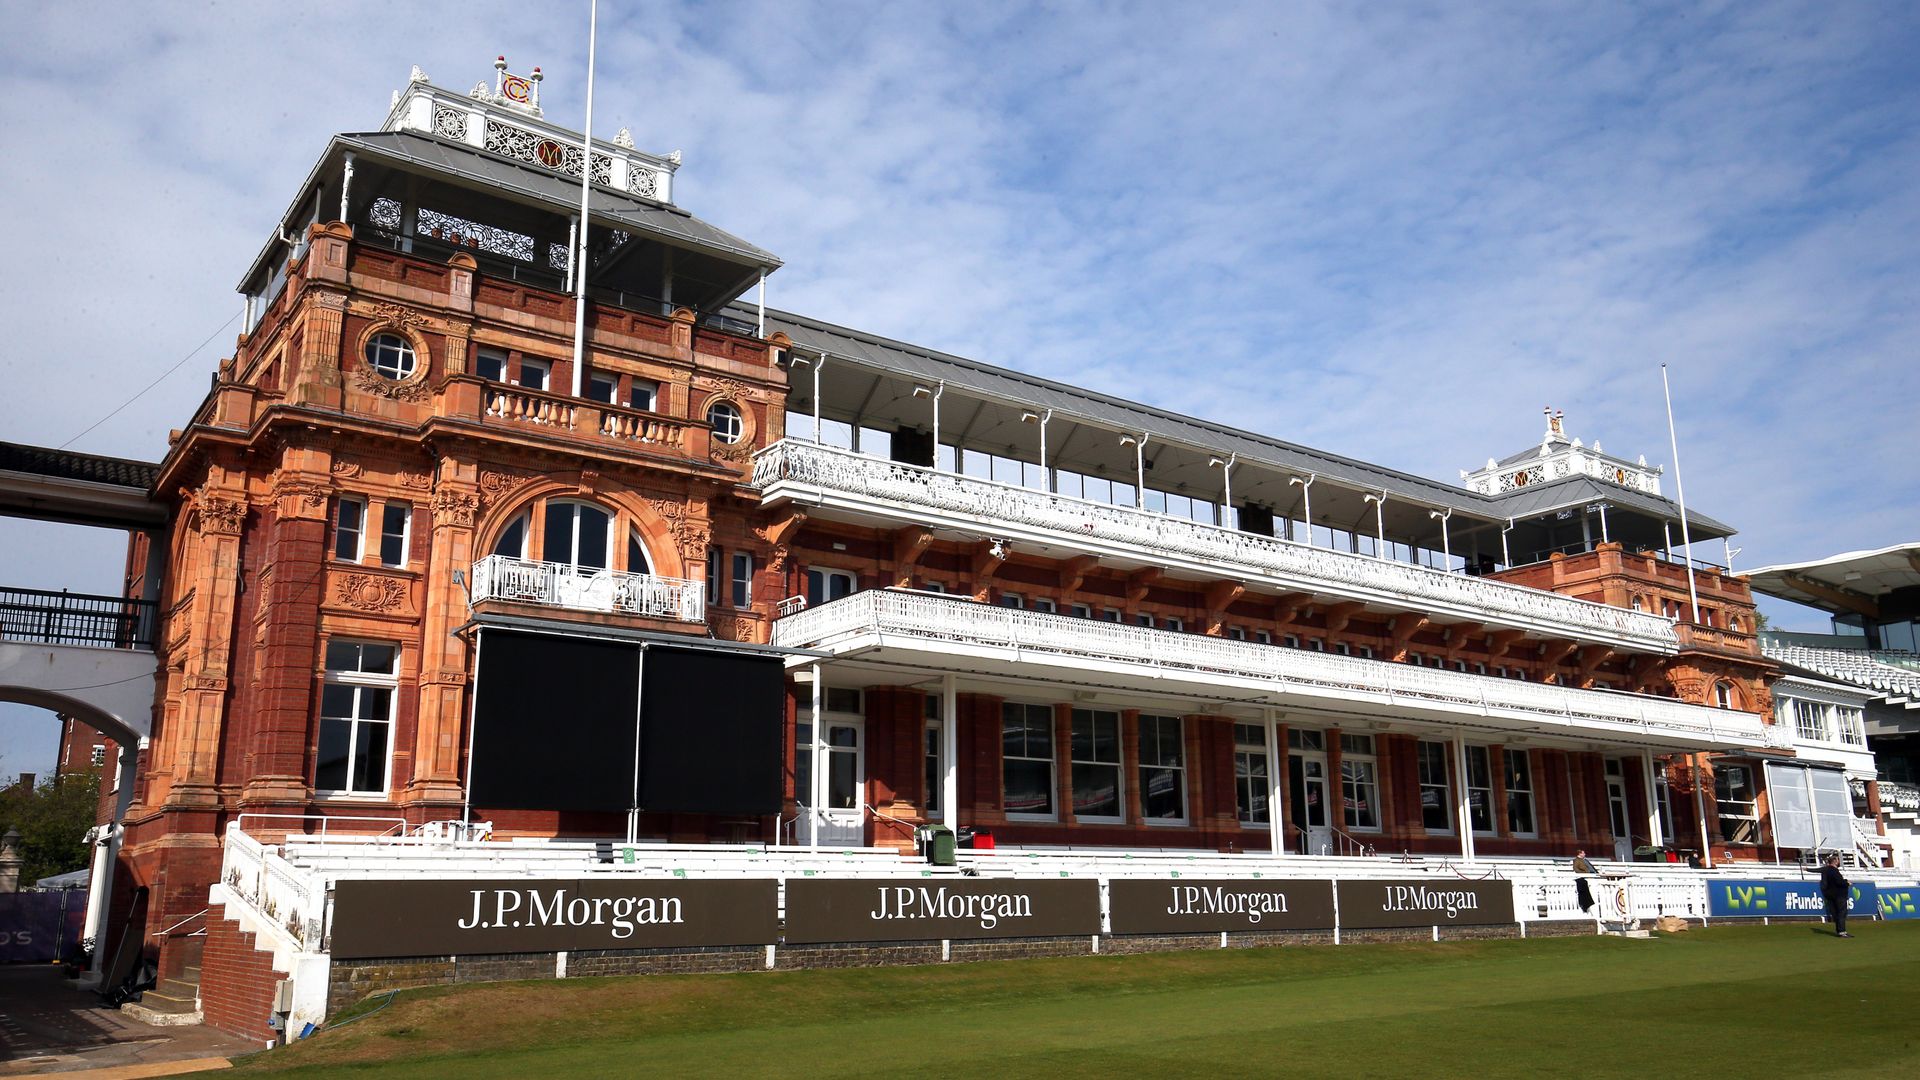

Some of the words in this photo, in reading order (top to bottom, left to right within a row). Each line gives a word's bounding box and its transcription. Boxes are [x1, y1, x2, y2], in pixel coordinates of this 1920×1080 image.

[458, 889, 684, 939] J.P.Morgan
[871, 887, 1033, 929] J.P.Morgan
[1167, 886, 1288, 923] J.P.Morgan
[1383, 886, 1478, 918] J.P.Morgan
